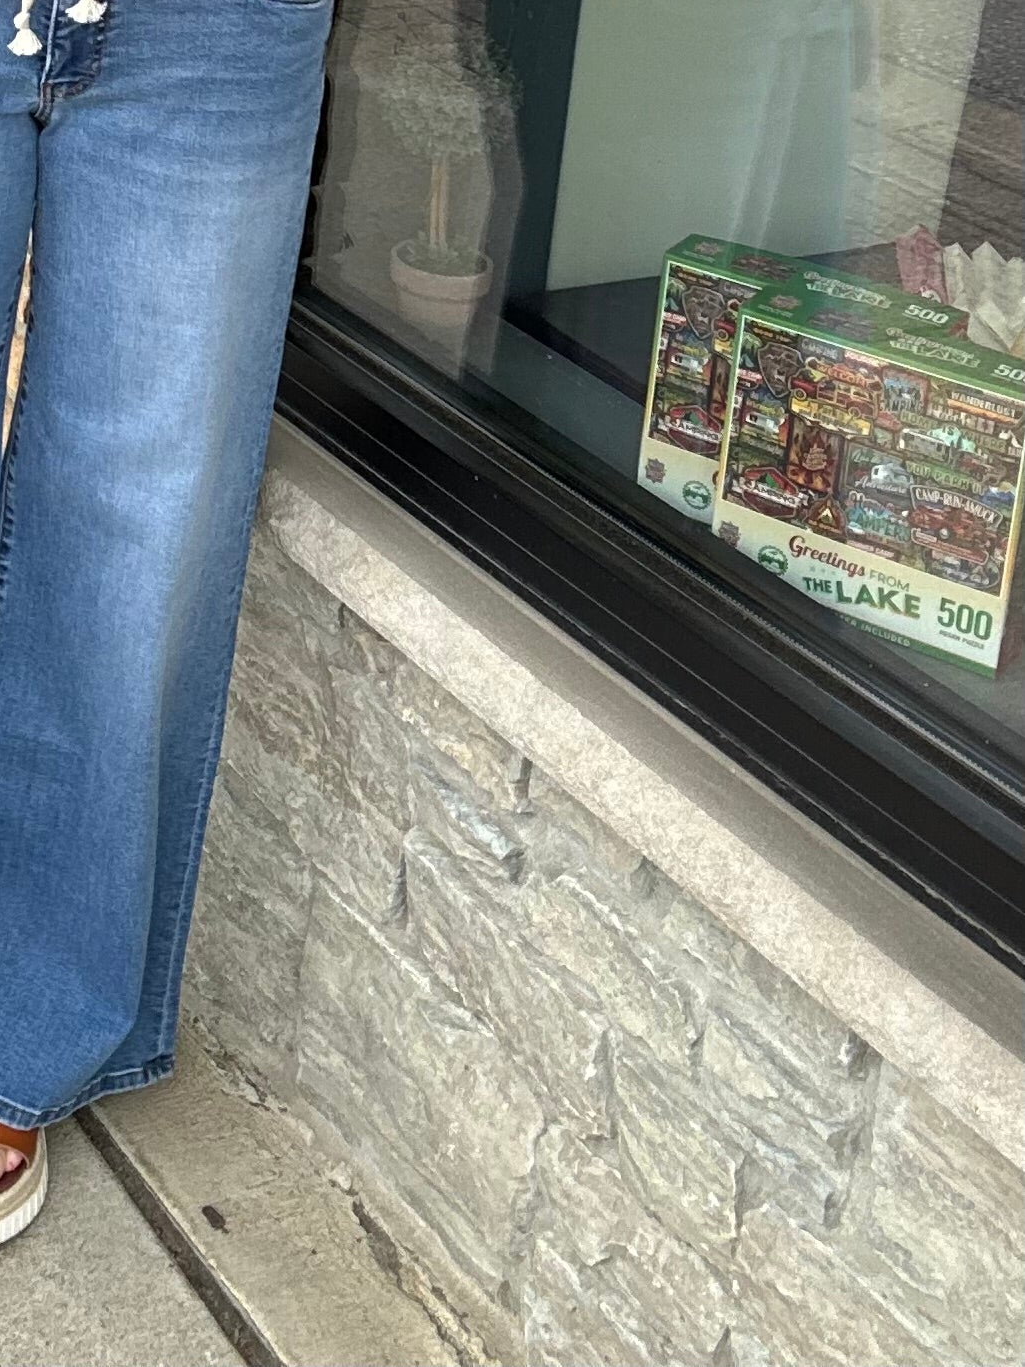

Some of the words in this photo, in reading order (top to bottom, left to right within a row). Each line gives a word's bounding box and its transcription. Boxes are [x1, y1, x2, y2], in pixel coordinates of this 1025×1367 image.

[904, 304, 949, 325] 500
[788, 535, 866, 578] Greetings
[869, 569, 910, 593] FROM
[803, 576, 833, 594] THE
[835, 580, 921, 620] LAKE
[937, 596, 994, 641] 500
